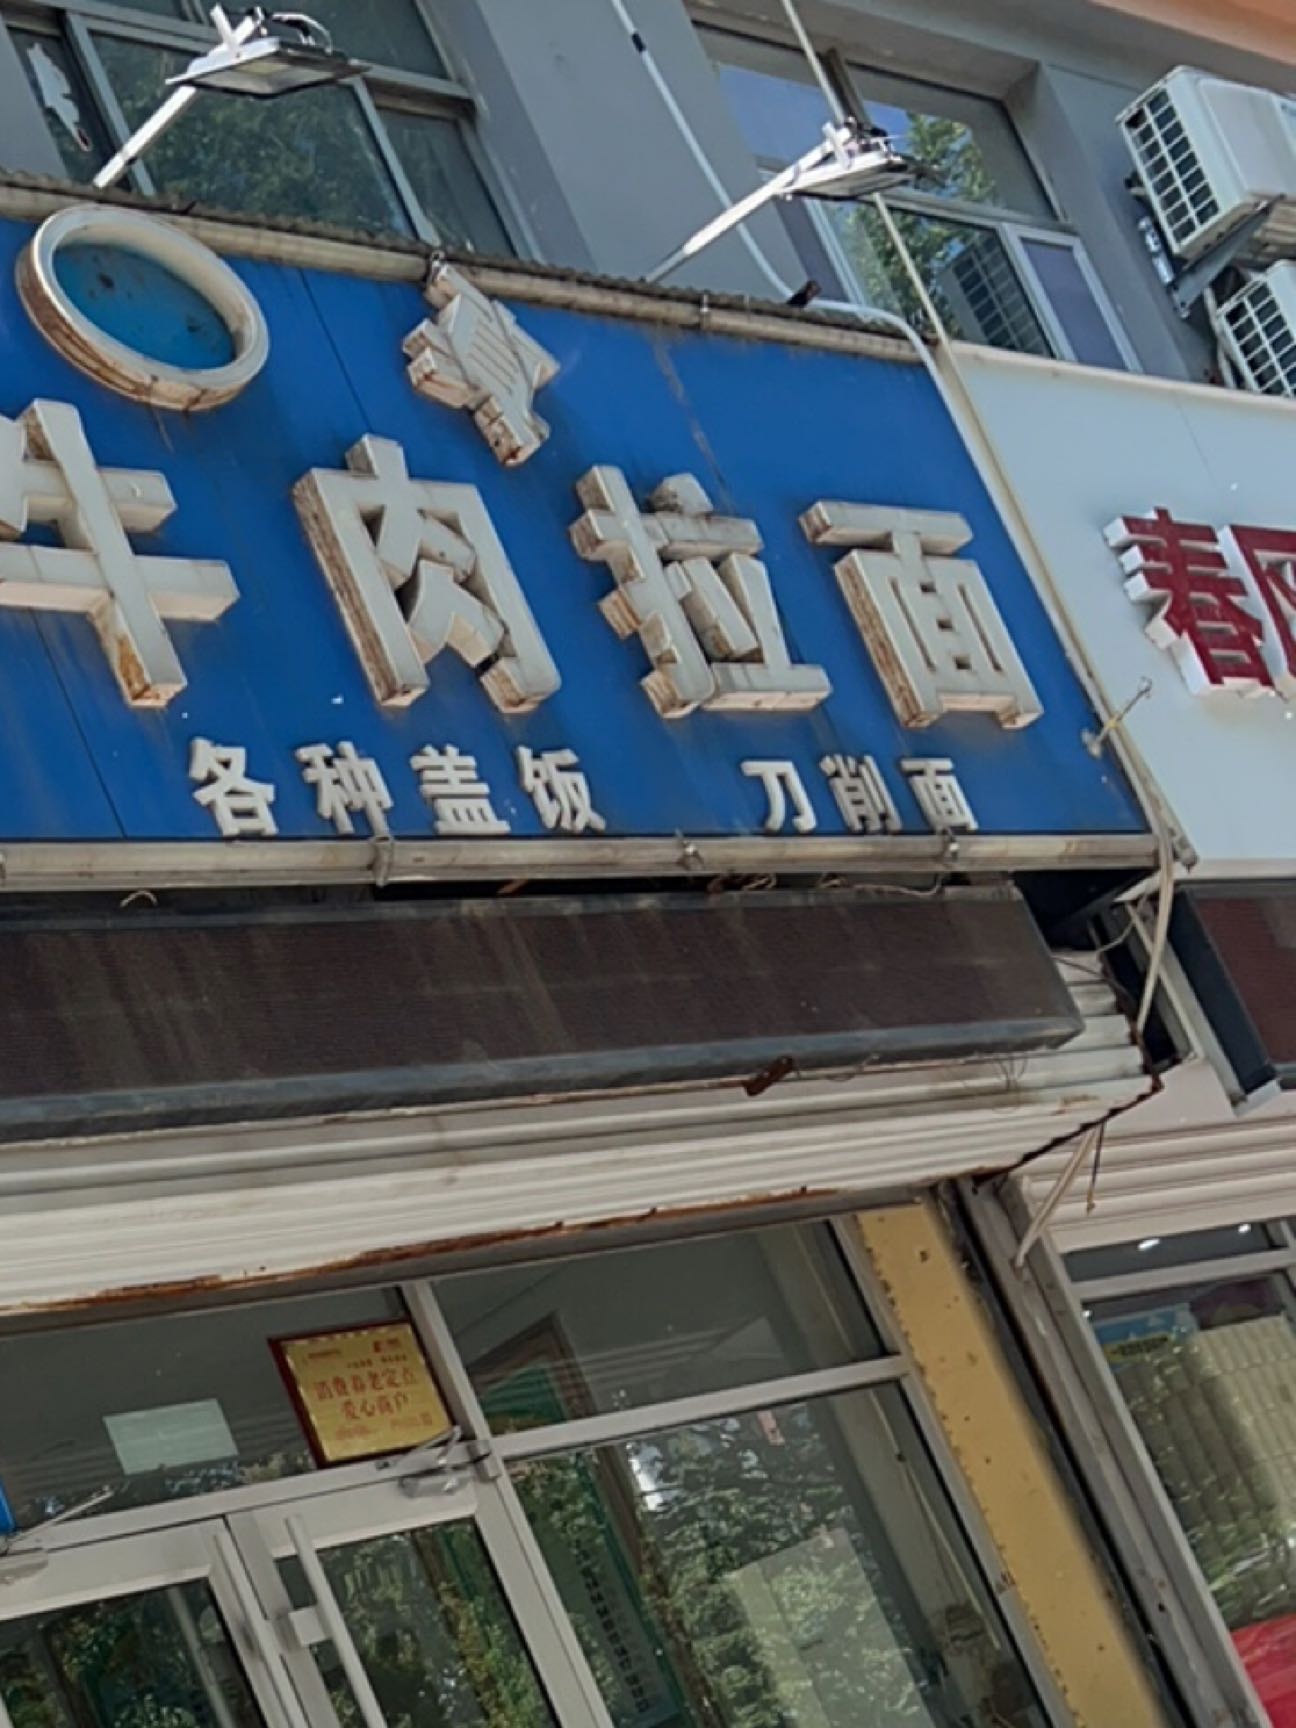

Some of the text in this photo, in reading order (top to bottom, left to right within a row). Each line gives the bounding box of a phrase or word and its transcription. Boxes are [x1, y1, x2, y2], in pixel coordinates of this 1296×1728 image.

[190, 738, 605, 838] 各种盖饭
[742, 755, 980, 836] 刀削面
